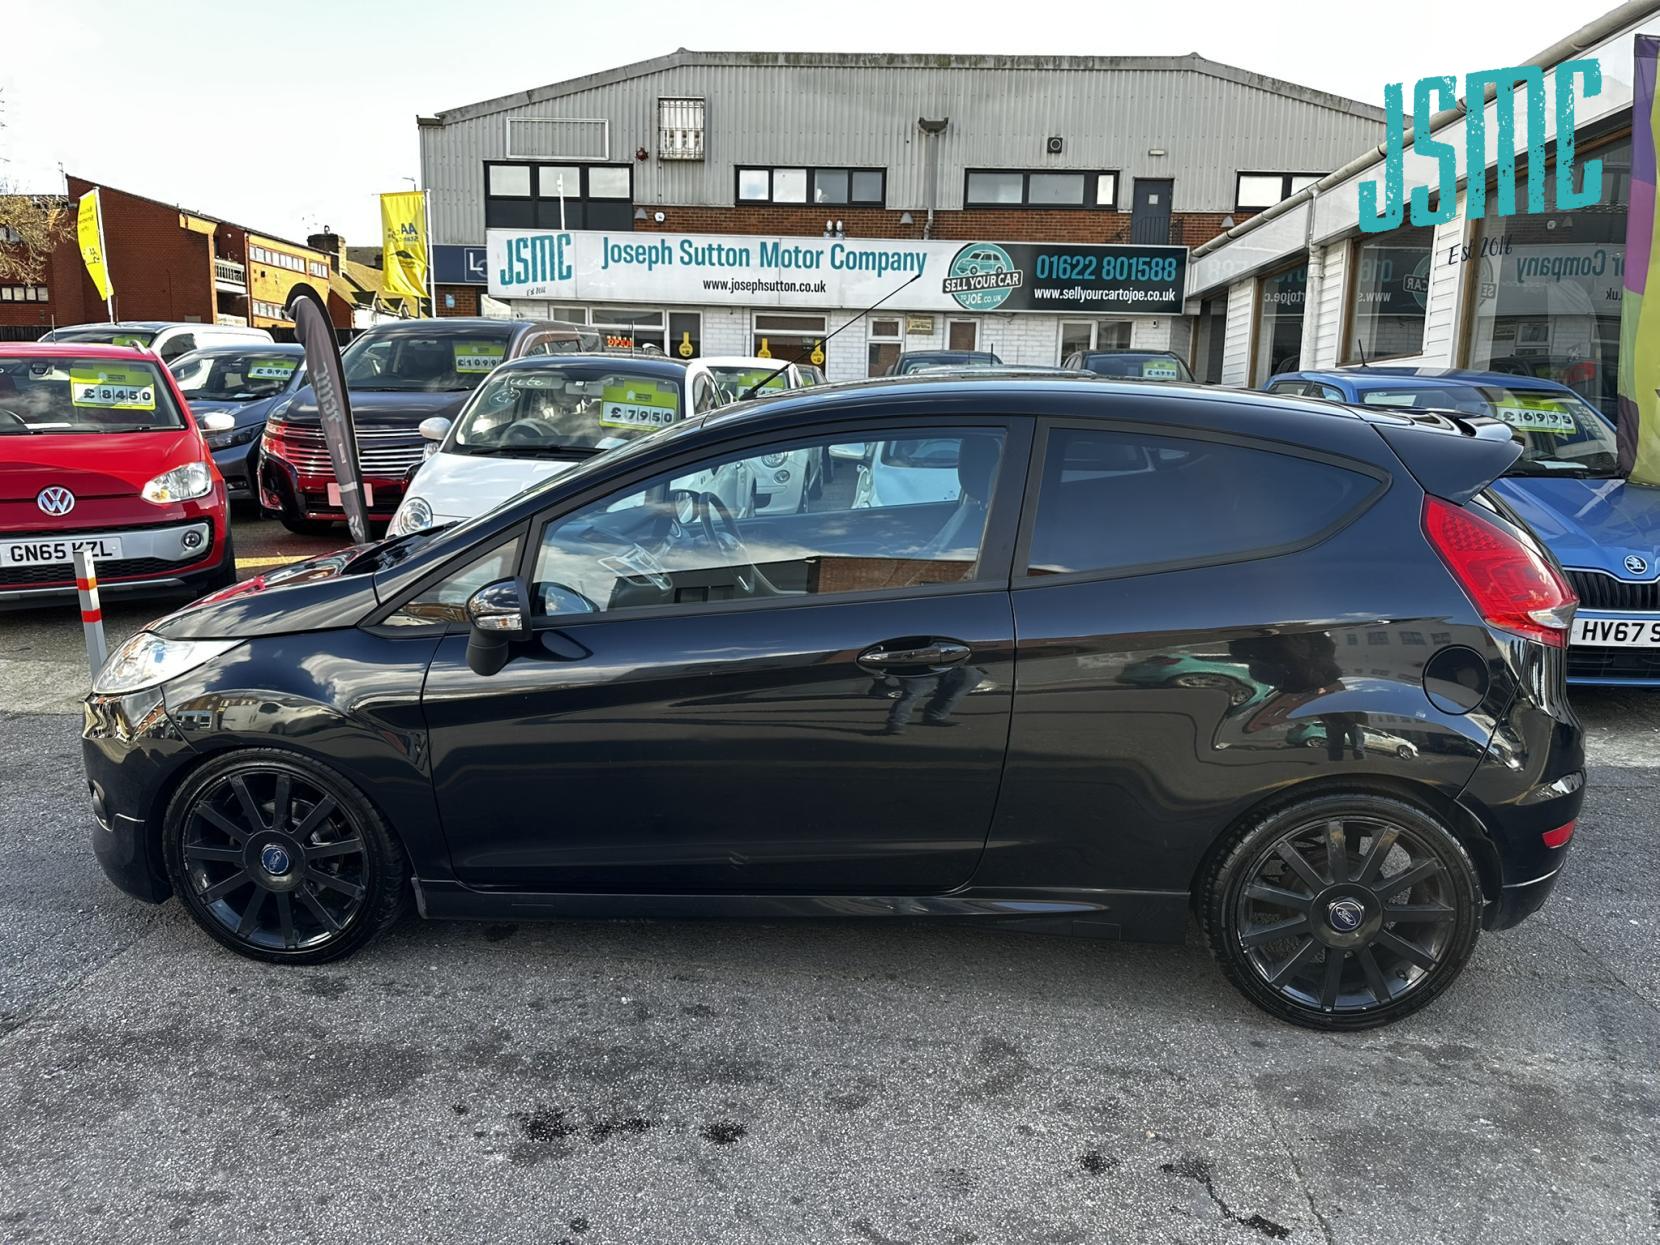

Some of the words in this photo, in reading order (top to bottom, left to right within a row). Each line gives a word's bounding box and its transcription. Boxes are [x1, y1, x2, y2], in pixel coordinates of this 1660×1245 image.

[500, 233, 572, 286] JSMC
[601, 237, 672, 271] Joseph
[679, 239, 750, 268] Sutton
[760, 242, 824, 269] Motor
[830, 244, 927, 277] Company
[1036, 255, 1096, 280] 01622
[1102, 256, 1177, 282] 801588
[703, 278, 826, 294] www.josephsutton.co.uk
[945, 278, 968, 292] SELL
[969, 274, 997, 289] YOUR
[998, 272, 1019, 286] CAR
[1034, 287, 1175, 304] www.sellyourcartojoe.co.uk
[10, 543, 66, 562] GN65
[1581, 621, 1645, 642] HV67
